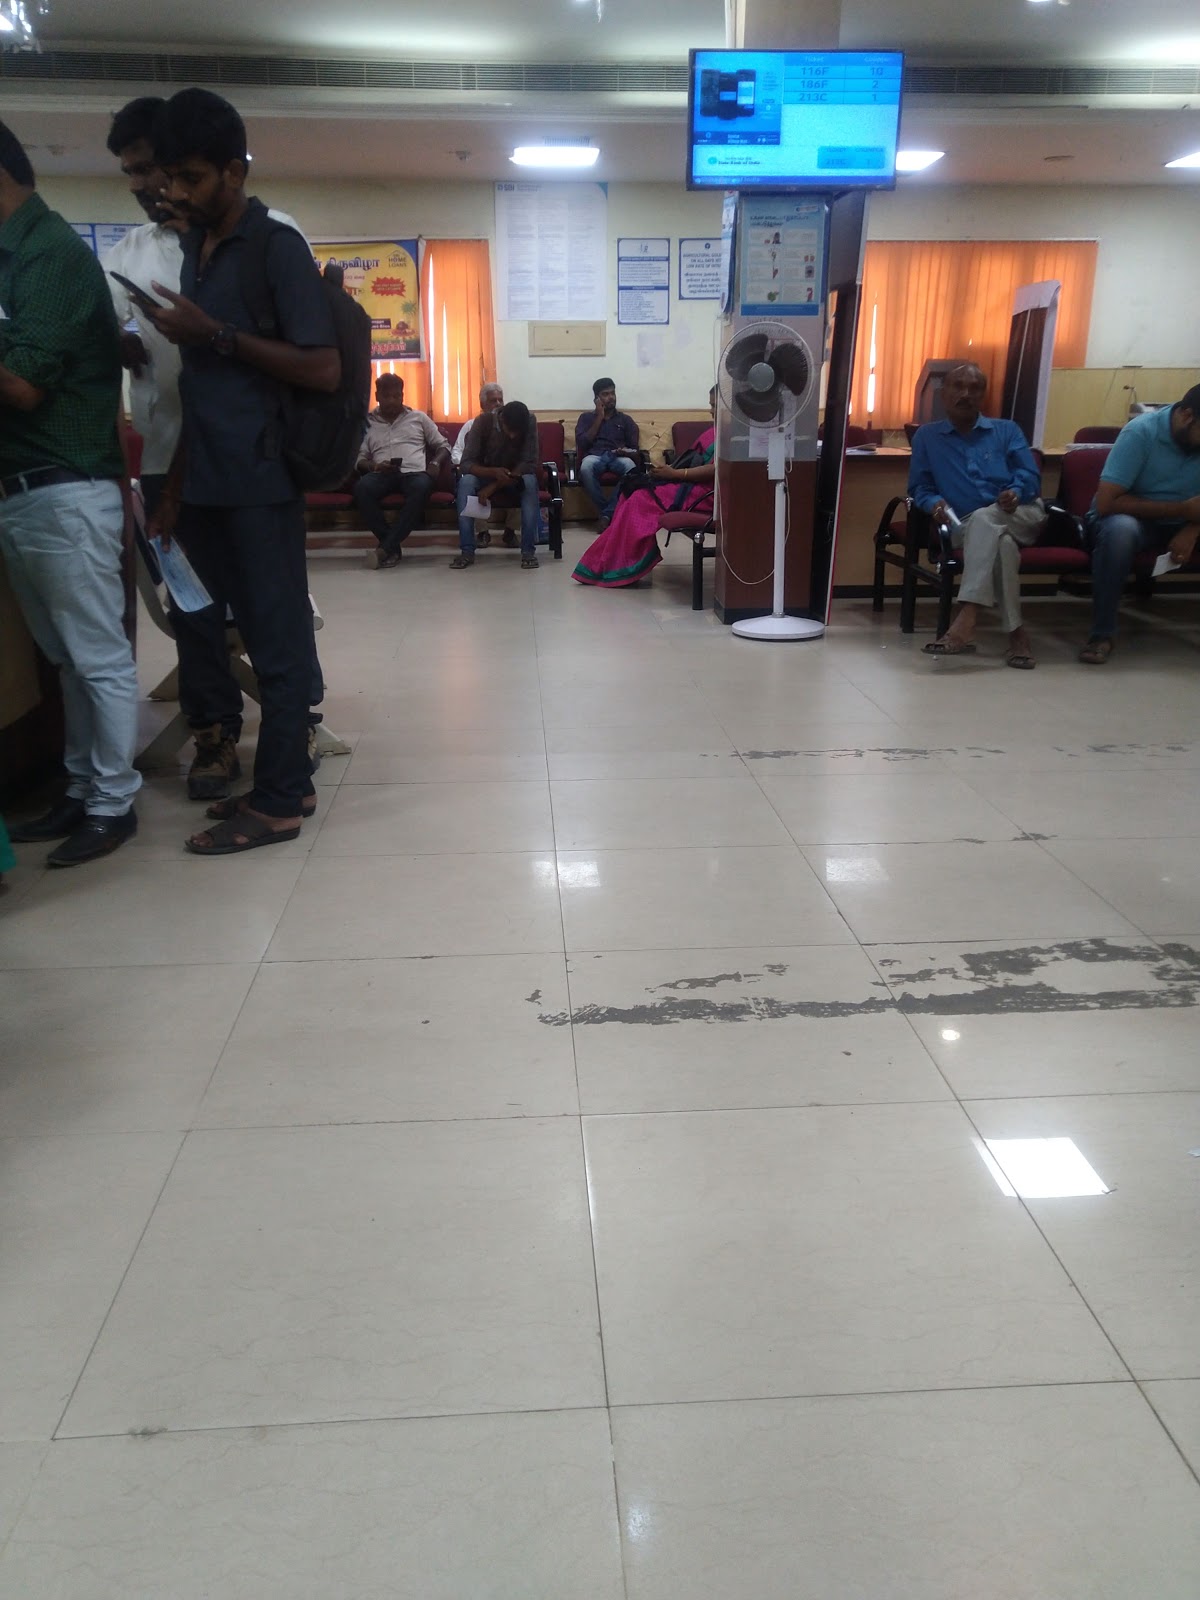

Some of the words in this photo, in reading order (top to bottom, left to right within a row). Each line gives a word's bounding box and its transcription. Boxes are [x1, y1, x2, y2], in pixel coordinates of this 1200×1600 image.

[801, 66, 830, 76] 116F
[800, 80, 829, 89] 186F
[872, 80, 879, 89] 2
[799, 92, 828, 102] 213C
[872, 93, 878, 102] 1
